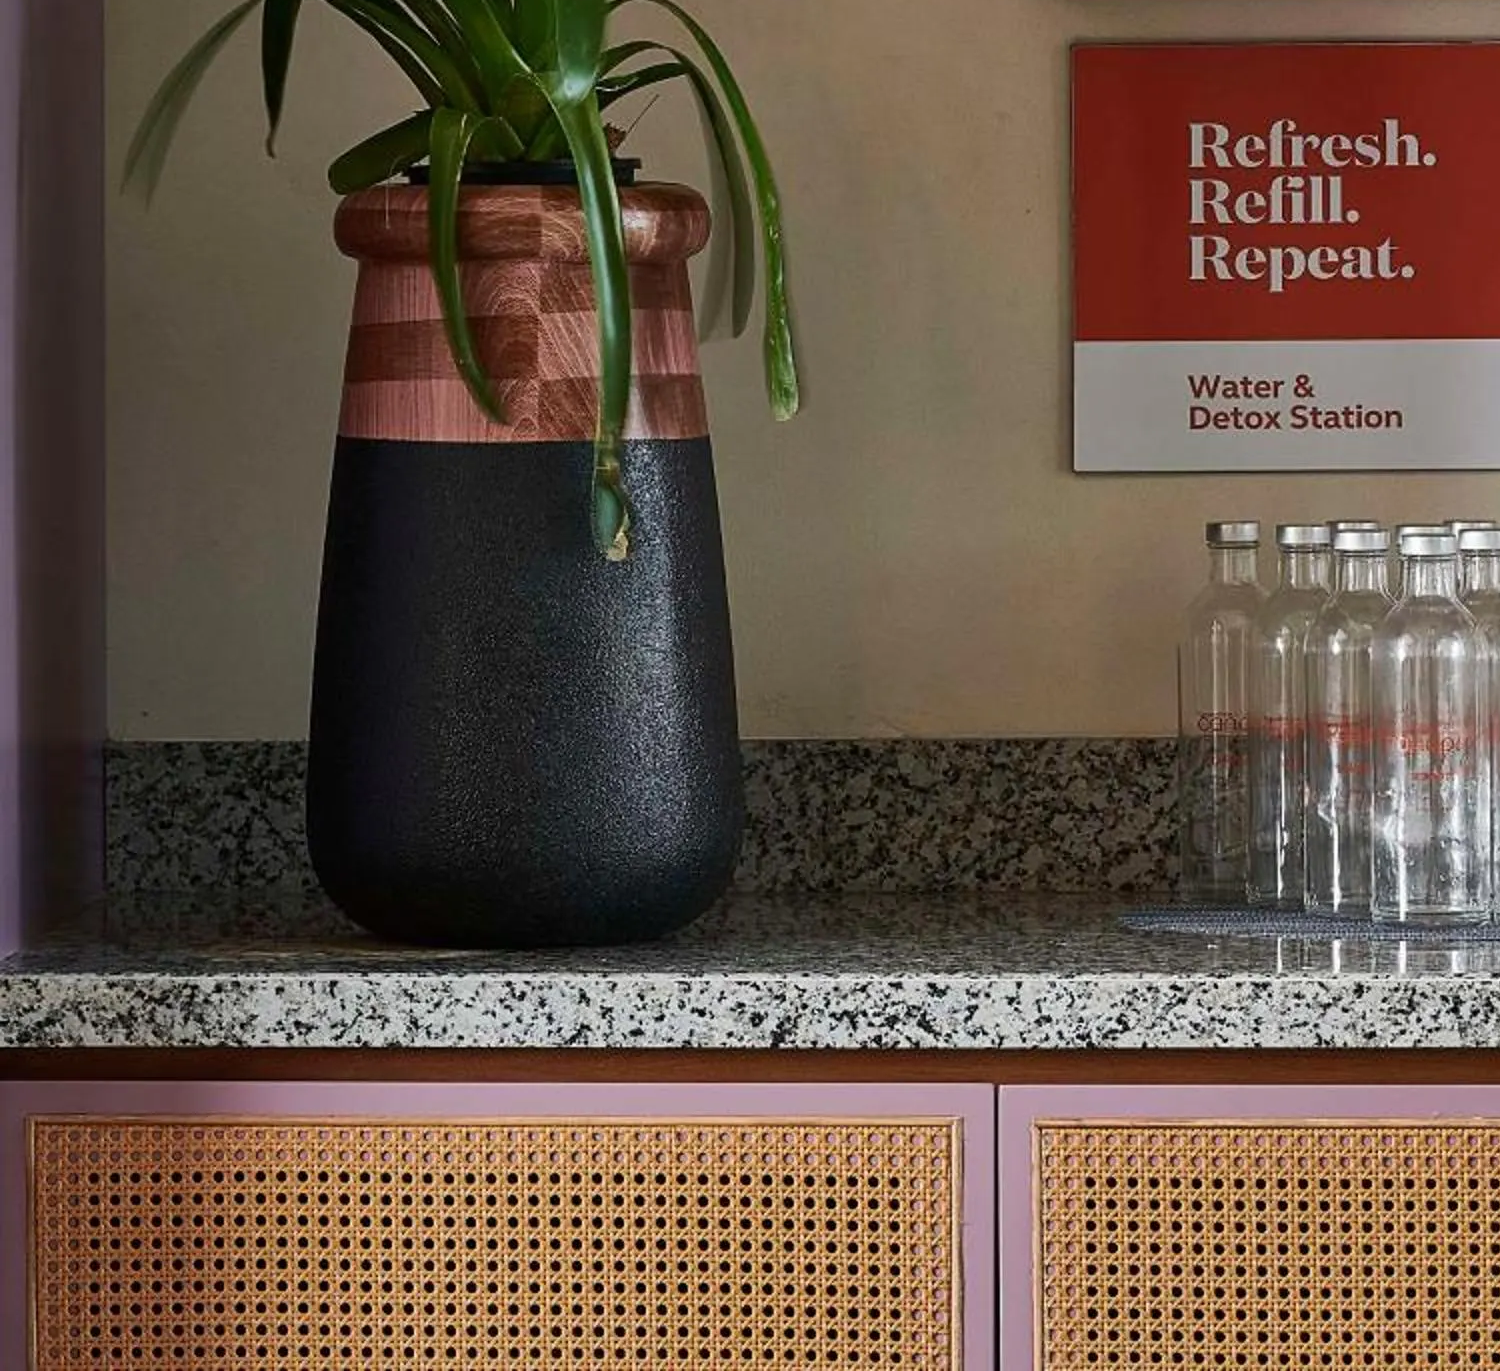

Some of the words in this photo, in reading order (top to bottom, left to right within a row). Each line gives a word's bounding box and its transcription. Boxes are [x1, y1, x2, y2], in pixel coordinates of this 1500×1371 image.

[1189, 118, 1437, 169] Refresh.
[1189, 175, 1360, 225] Refill.
[1189, 236, 1415, 293] Repeat.
[1188, 374, 1286, 400] Water
[1293, 374, 1316, 400] &
[1188, 405, 1283, 431] Detox
[1289, 402, 1403, 431] Station
